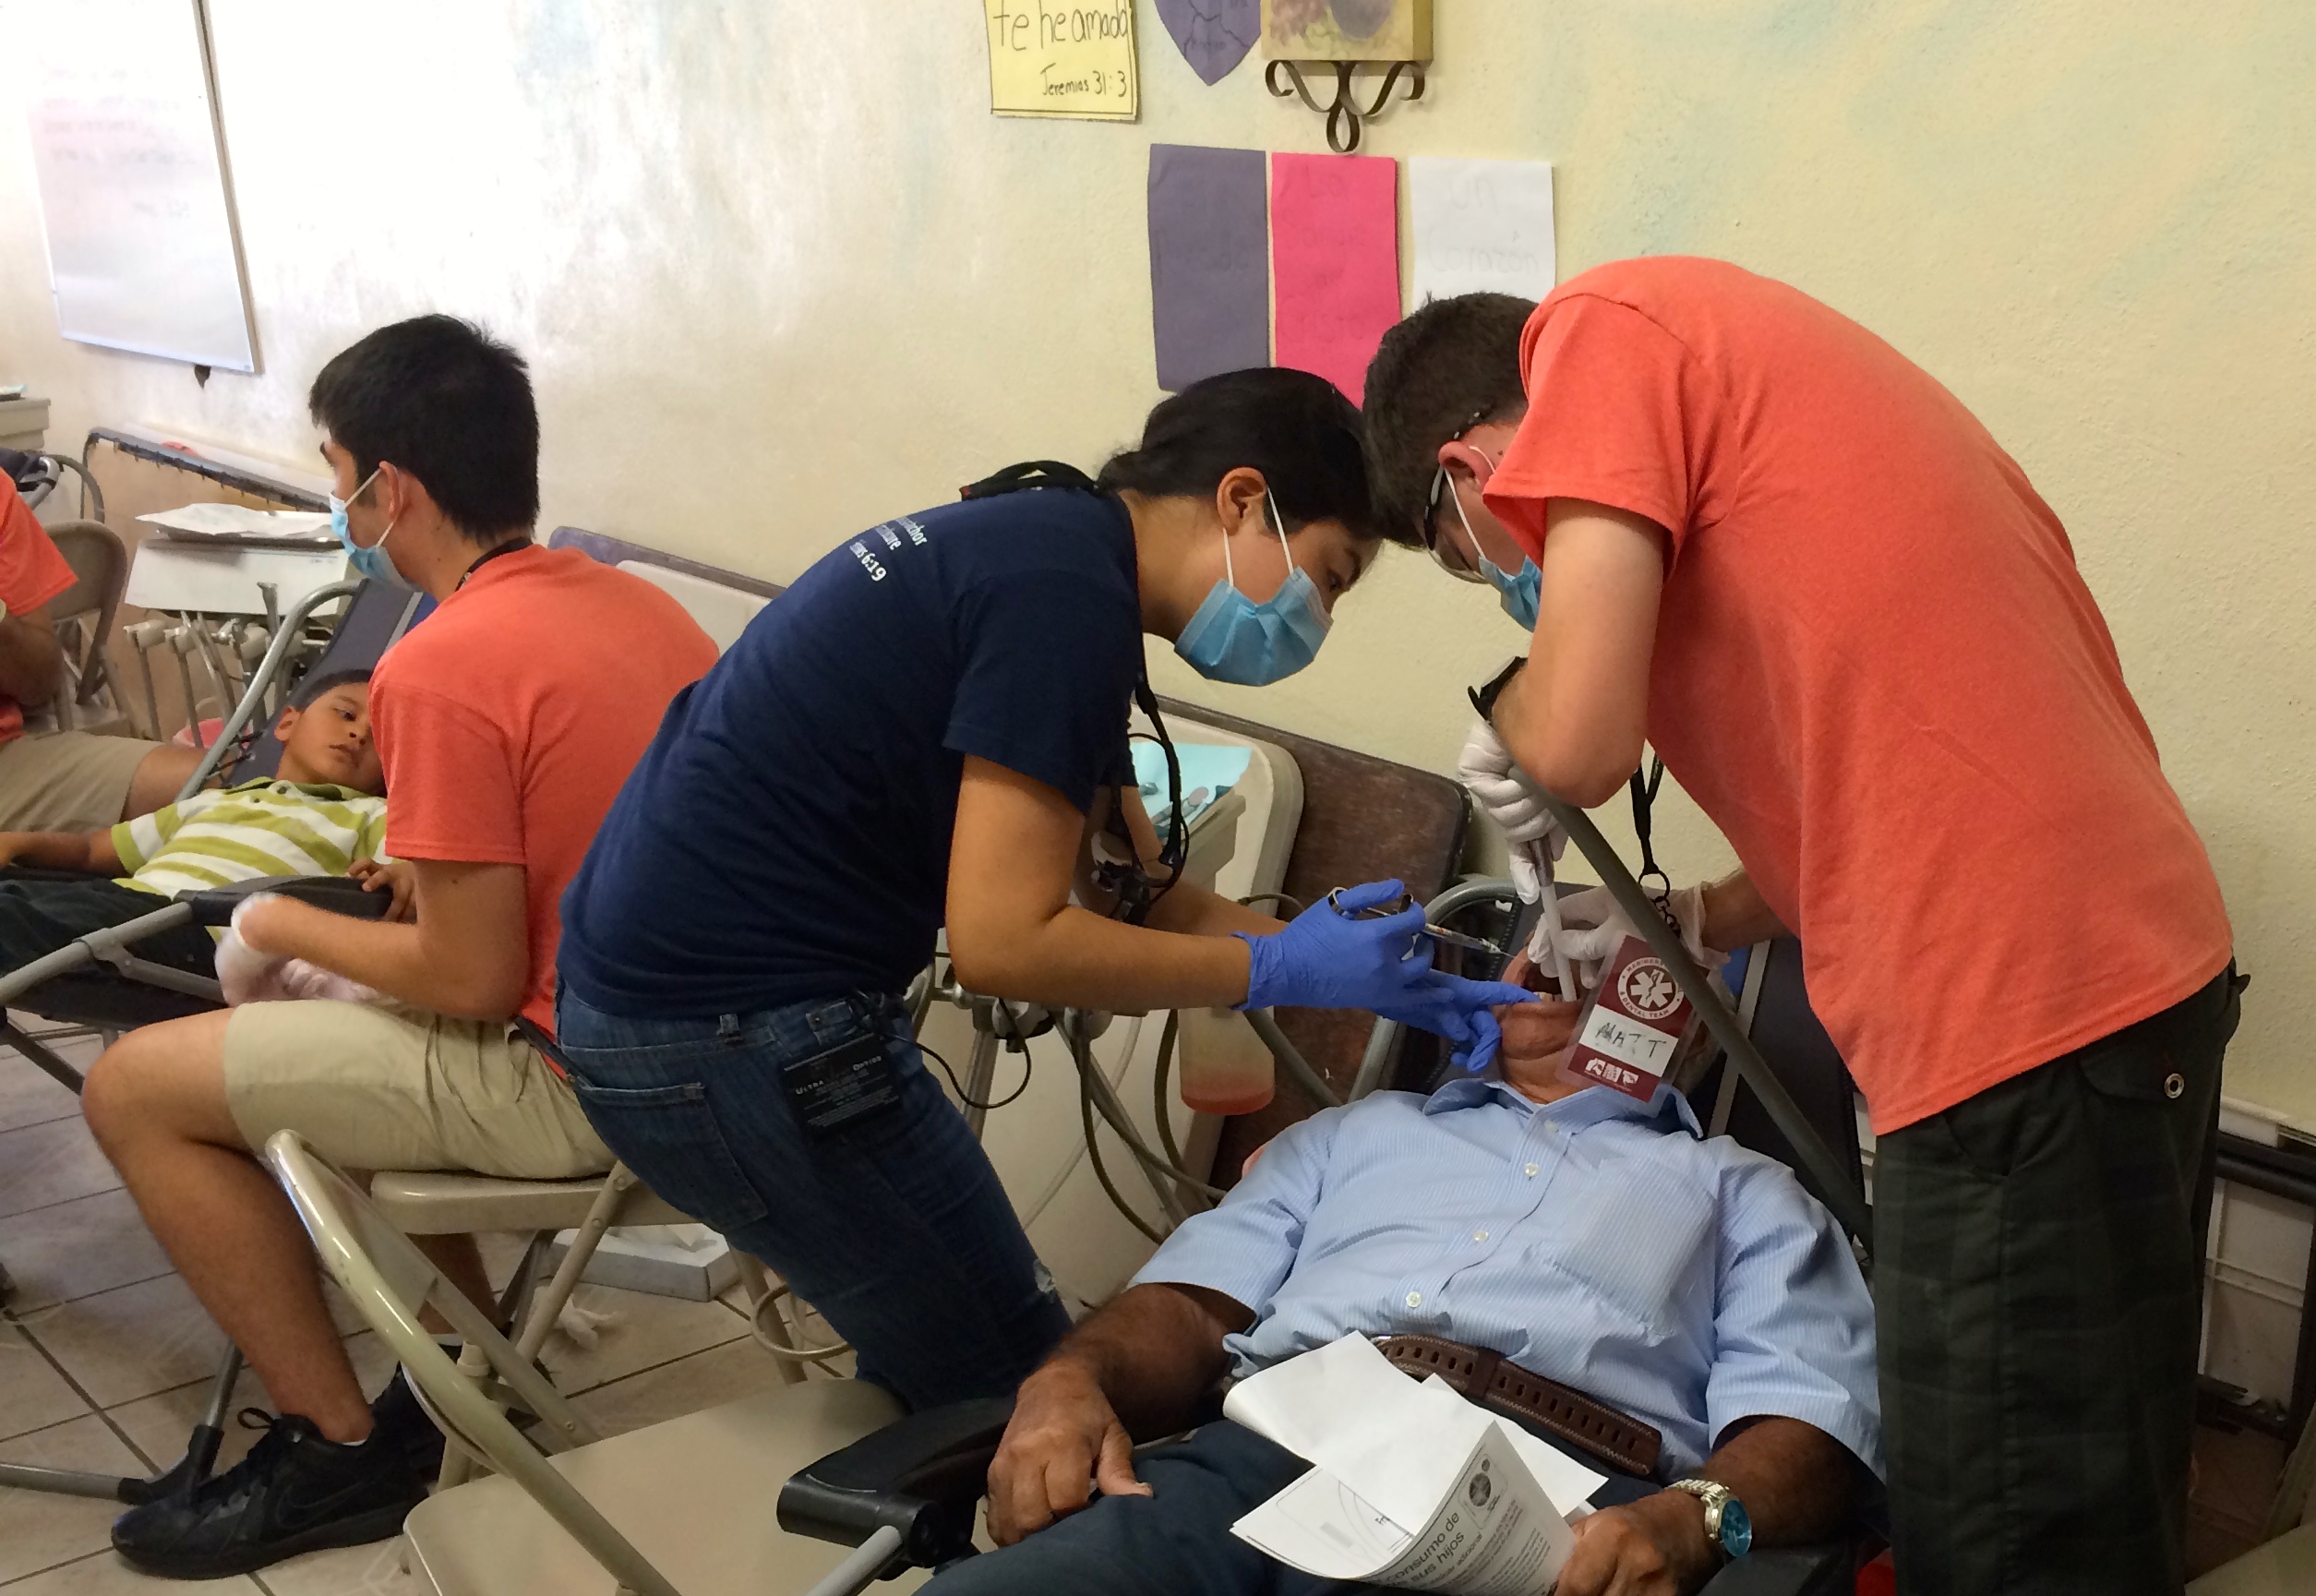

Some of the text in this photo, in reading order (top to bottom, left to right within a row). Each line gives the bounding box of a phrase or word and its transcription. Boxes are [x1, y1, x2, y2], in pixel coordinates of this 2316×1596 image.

[993, 0, 1030, 51] te
[1038, 0, 1066, 49] he
[860, 552, 887, 582] 6:19
[1622, 997, 1647, 1017] DENTAL
[1649, 1009, 1670, 1018] TEAM
[1386, 1532, 1446, 1582] consumo
[1445, 1511, 1460, 1532] de
[1410, 1531, 1465, 1582] sus hijos
